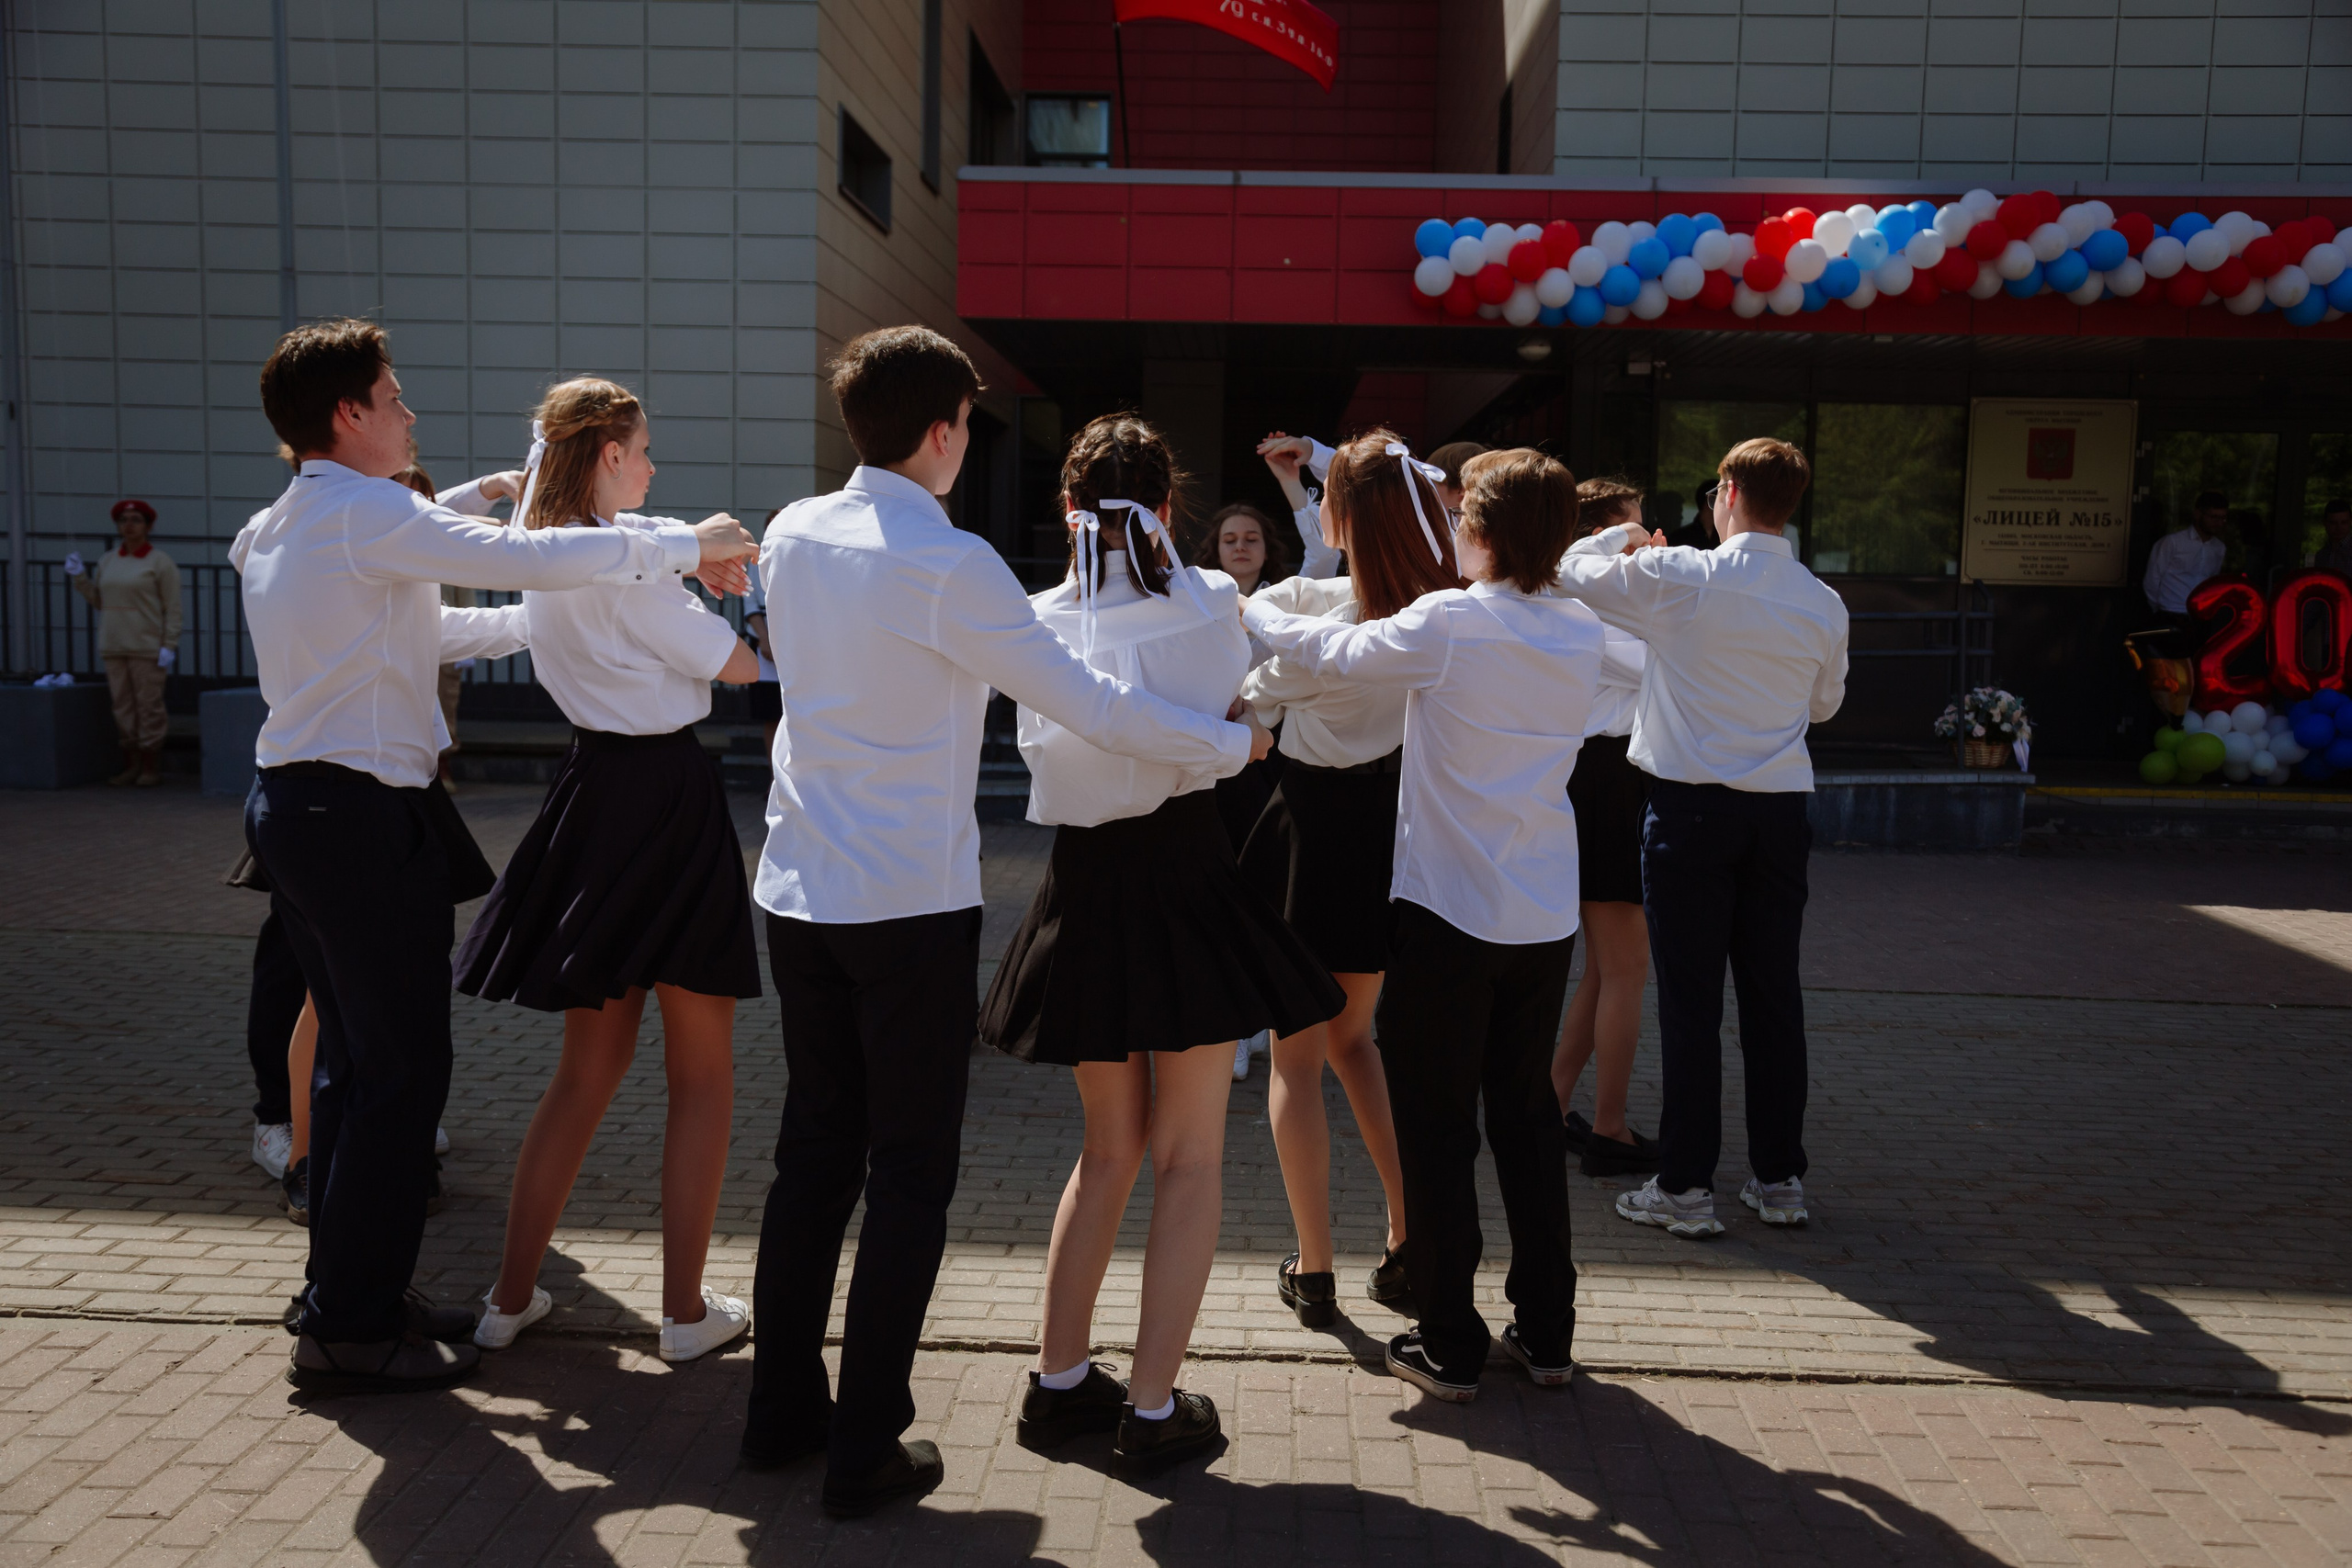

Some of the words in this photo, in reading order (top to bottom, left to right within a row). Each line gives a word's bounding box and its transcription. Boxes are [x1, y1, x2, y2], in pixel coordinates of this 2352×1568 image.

[1973, 508, 2060, 528] «ЛИЦЕЙ
[2069, 512, 2123, 527] №15»
[2186, 567, 2352, 708] 20
